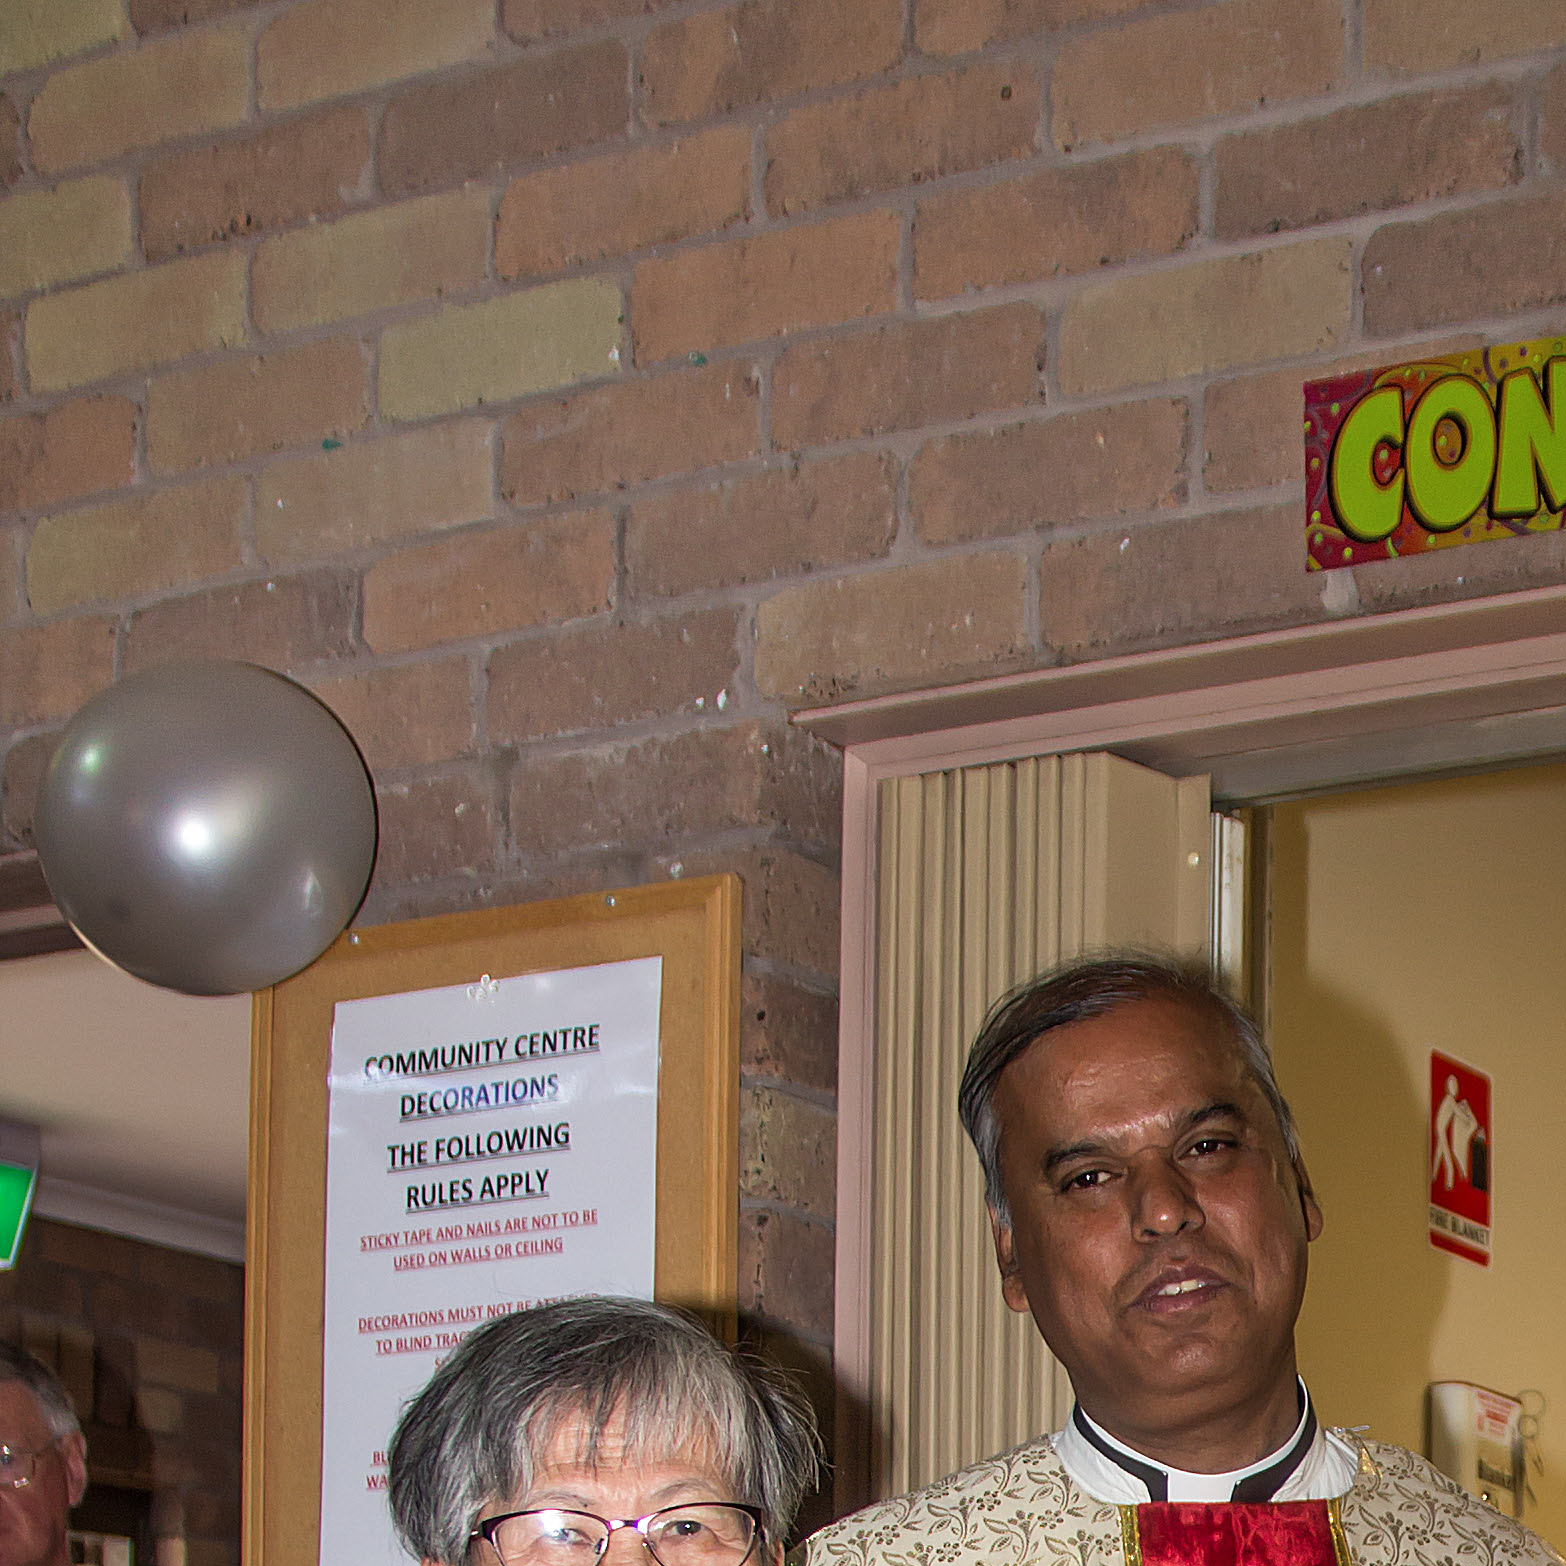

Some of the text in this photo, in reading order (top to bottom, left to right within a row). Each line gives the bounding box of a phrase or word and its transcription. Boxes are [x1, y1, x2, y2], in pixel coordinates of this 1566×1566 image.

[364, 1023, 601, 1078] COMMUNITY CENTRE
[400, 1073, 560, 1117] DECORATIONS
[387, 1122, 570, 1168] THE FOLLOWING
[406, 1168, 550, 1209] RULES APPLY
[360, 1208, 599, 1250] STICKY TAPE AND NAILS ARE NOT TO BE
[393, 1237, 564, 1271] USED ON WALLS OR CEILING
[358, 1309, 444, 1332] DECORATIONS
[447, 1305, 483, 1323] MUST
[487, 1301, 513, 1319] NOT
[376, 1330, 470, 1354] TO BLIND TRAC
